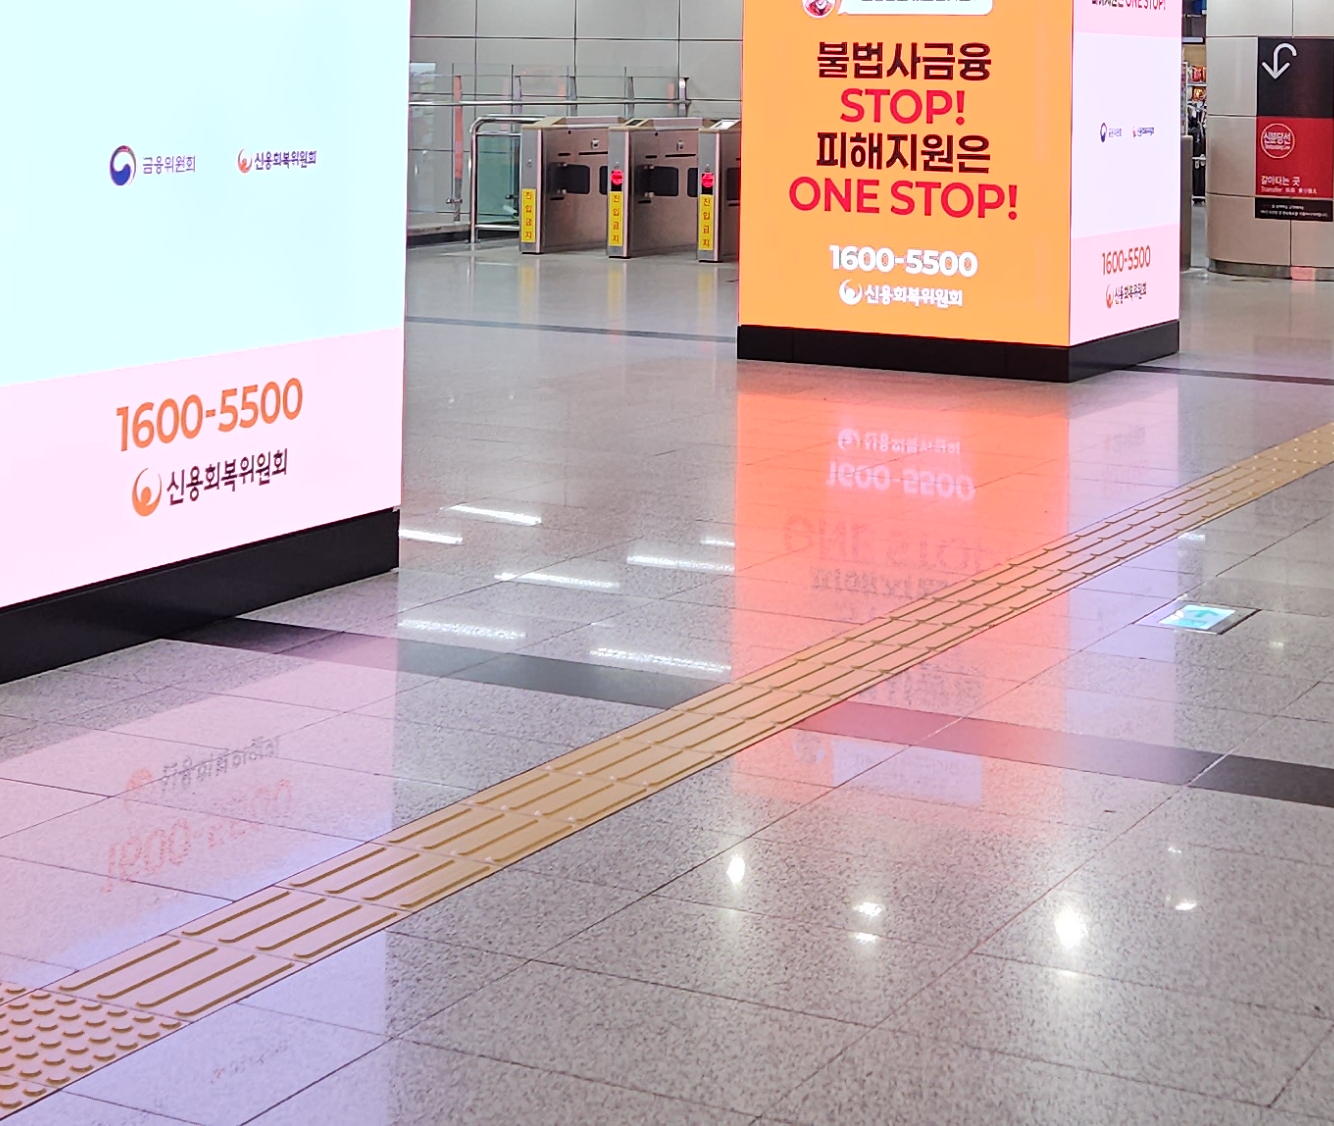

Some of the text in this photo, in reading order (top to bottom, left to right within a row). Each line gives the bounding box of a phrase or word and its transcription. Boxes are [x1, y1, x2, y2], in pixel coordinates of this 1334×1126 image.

[817, 41, 992, 82] 불법사금융
[840, 88, 966, 126] STOP!
[142, 154, 197, 175] 금융위원회
[253, 149, 318, 172] 신용회복위원회
[816, 132, 991, 174] 피해지원은
[789, 176, 1018, 221] ONE STOP!
[1261, 175, 1301, 187] 갈아타는 곳
[612, 194, 621, 244] 진입금지
[702, 197, 712, 249] 진입금지
[828, 244, 979, 278] 1600-5500
[1101, 245, 1151, 276] 1600-5500
[865, 284, 963, 309] 신용회복위원회
[116, 377, 303, 452] 1600-5500
[166, 448, 289, 506] 신용회복위원회
